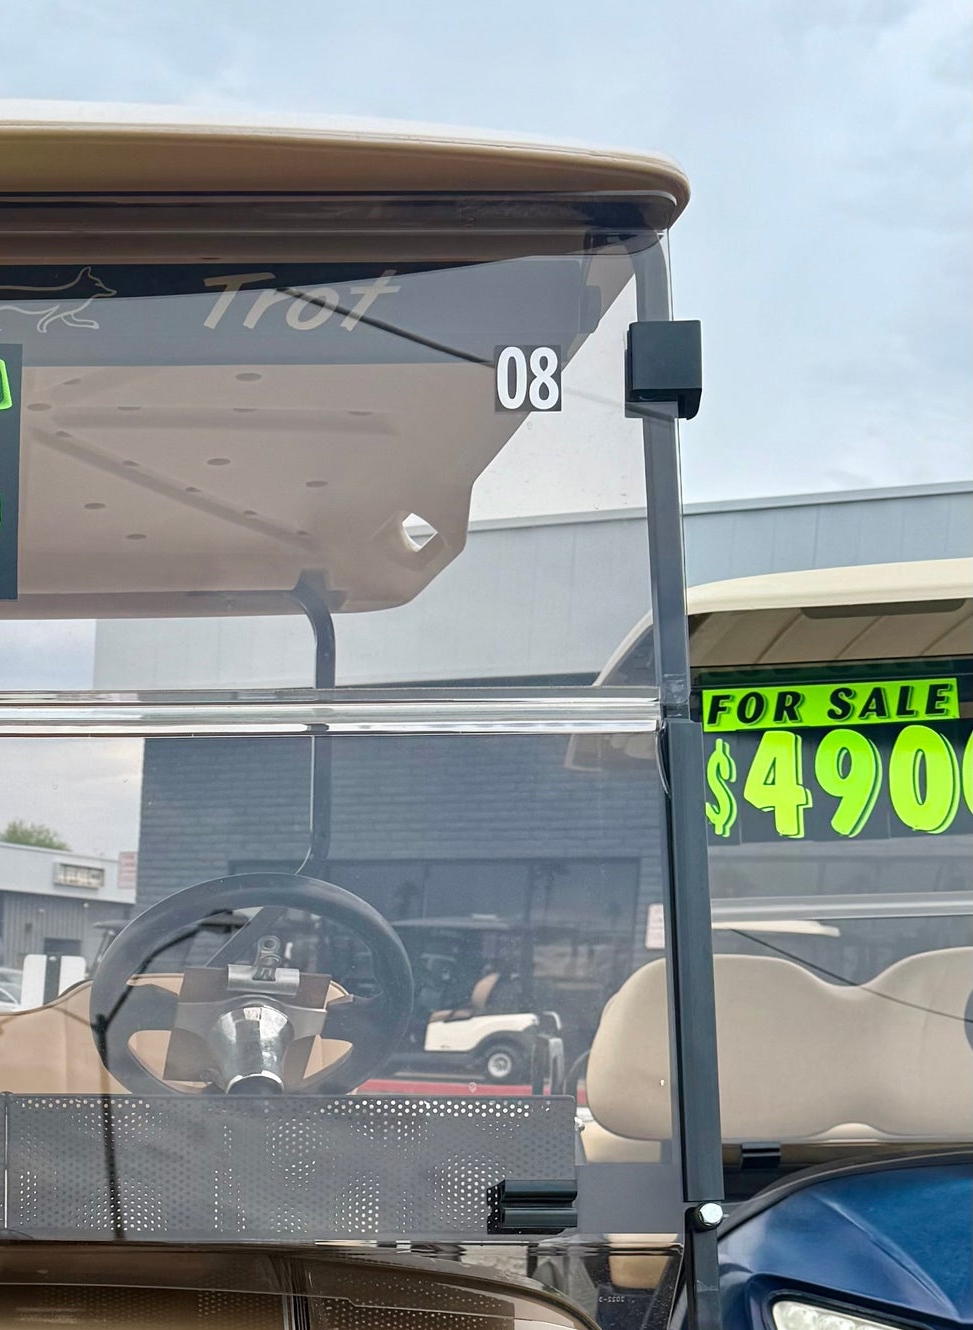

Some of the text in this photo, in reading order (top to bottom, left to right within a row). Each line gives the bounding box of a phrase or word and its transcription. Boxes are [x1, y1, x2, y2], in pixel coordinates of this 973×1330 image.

[203, 269, 402, 332] Trot
[496, 345, 560, 410] 08
[706, 682, 953, 727] FOR SALE
[705, 724, 973, 839] $490
